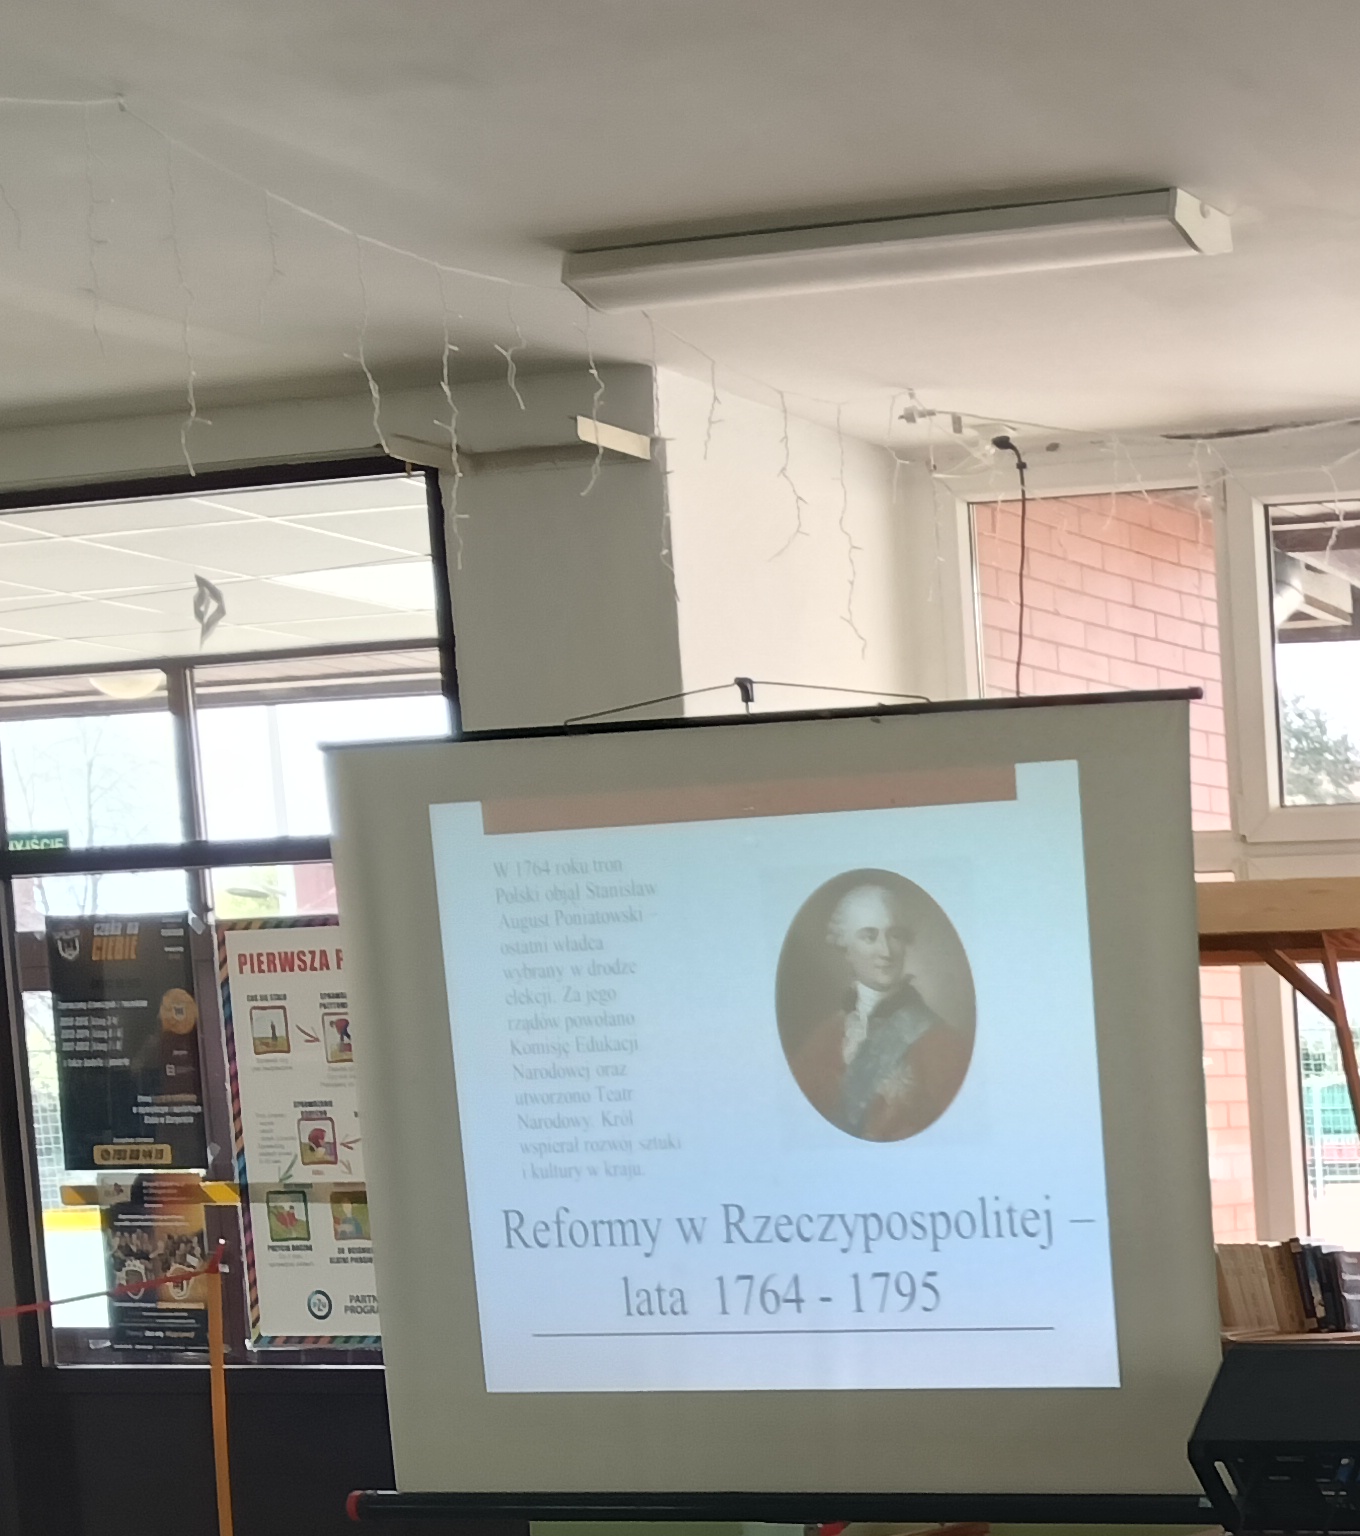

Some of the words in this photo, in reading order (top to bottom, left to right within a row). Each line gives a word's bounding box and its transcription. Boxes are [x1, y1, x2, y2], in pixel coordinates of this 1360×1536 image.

[494, 862, 508, 877] W
[516, 860, 550, 877] 1764
[555, 858, 589, 875] roku
[593, 859, 623, 873] tron
[496, 886, 540, 904] Polski
[586, 879, 657, 899] Stanisław
[500, 912, 550, 933] August
[555, 907, 643, 926] Poniatowski
[500, 937, 548, 955] ostatni
[554, 934, 604, 952] władca
[238, 949, 331, 975] PIERWSZA
[503, 962, 564, 984] wybrany
[570, 964, 583, 977] w
[588, 958, 637, 976] drodze
[562, 985, 581, 1003] Za
[586, 986, 617, 1006] jego
[508, 1012, 559, 1034] rządów
[565, 1011, 635, 1032] powołano
[510, 1038, 570, 1056] Komisję
[576, 1035, 639, 1055] Edukacji
[513, 1062, 590, 1081] Narodowej
[596, 1063, 627, 1077] oraz
[515, 1089, 590, 1106] utworzono
[596, 1086, 634, 1103] Teatr
[601, 1110, 634, 1127] Król
[521, 1136, 579, 1157] wspierał
[584, 1137, 633, 1156] rozwój
[640, 1133, 681, 1151] sztuki
[530, 1162, 582, 1182] kultury
[587, 1165, 599, 1177] w
[502, 1207, 661, 1257] Reformy
[676, 1214, 709, 1246] w
[722, 1194, 1054, 1253] Rzeczypospolitej
[622, 1278, 688, 1319] lata
[715, 1273, 806, 1317] 1764
[850, 1271, 940, 1314] 1795
